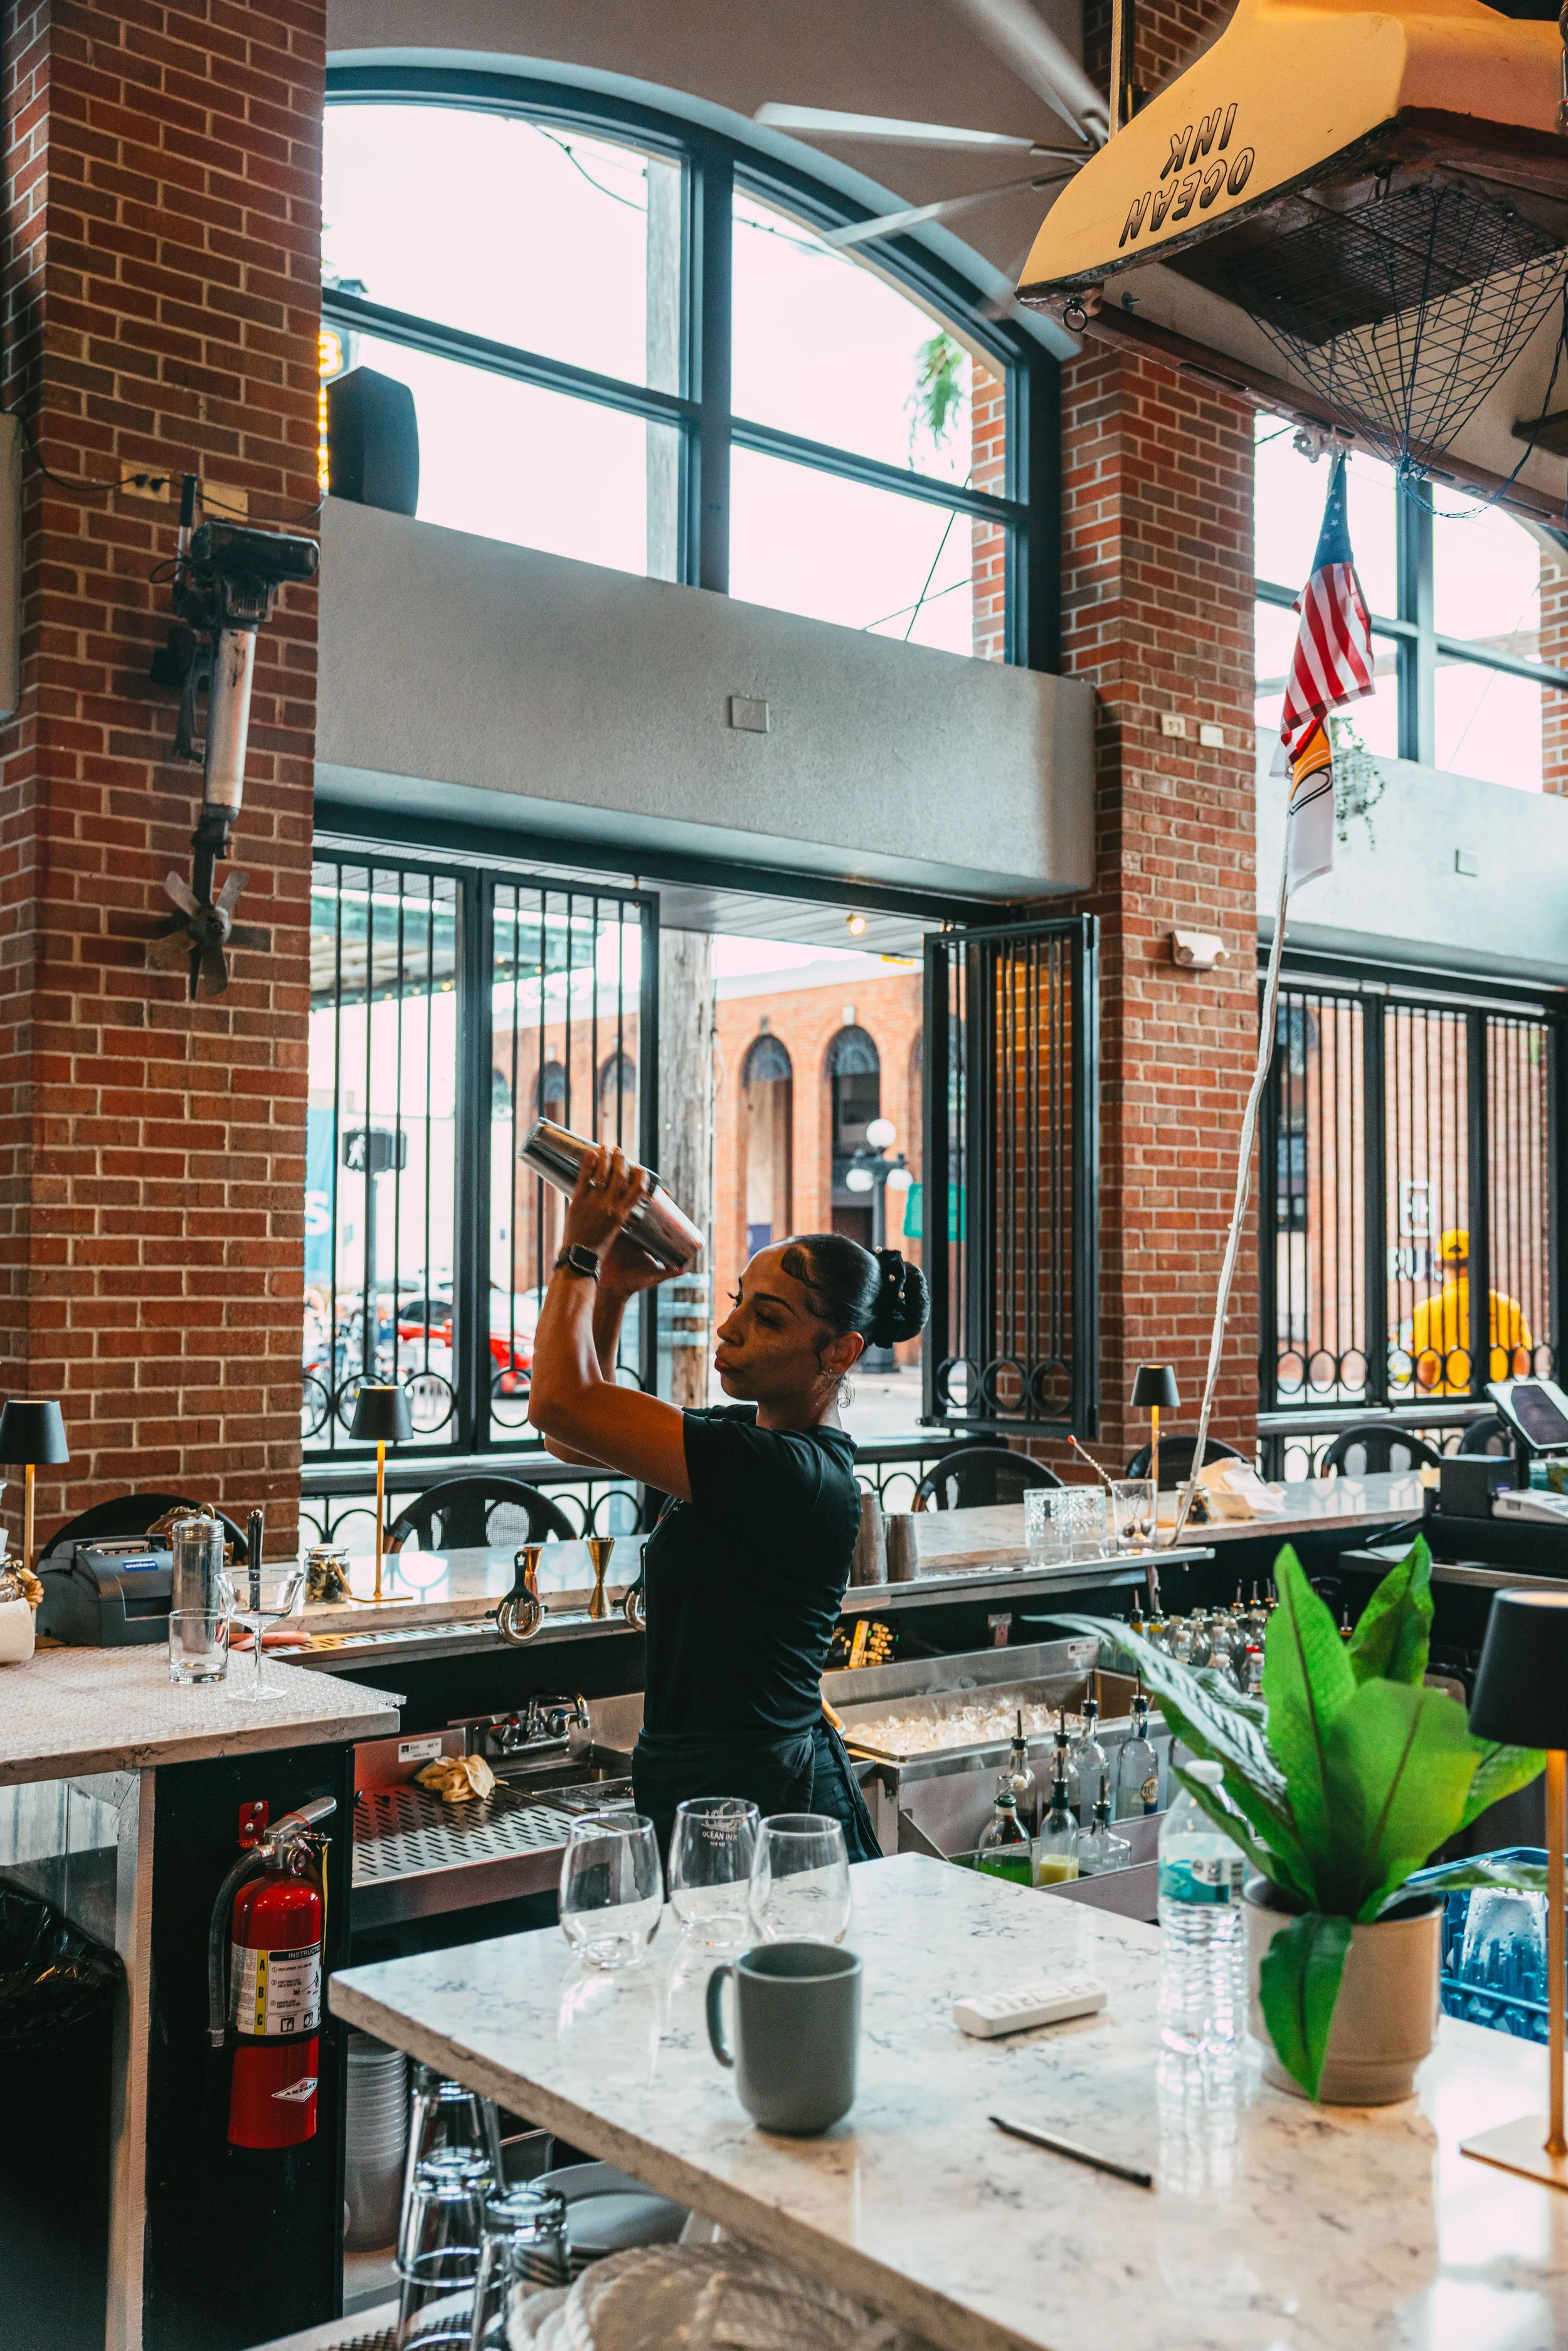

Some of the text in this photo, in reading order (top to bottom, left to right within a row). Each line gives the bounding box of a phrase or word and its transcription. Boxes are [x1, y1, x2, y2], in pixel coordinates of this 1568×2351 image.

[1160, 103, 1238, 181] INK
[1118, 147, 1255, 248] OCEAN
[702, 1831, 738, 1841] OCEAN INK
[257, 1959, 265, 2026] A B C
